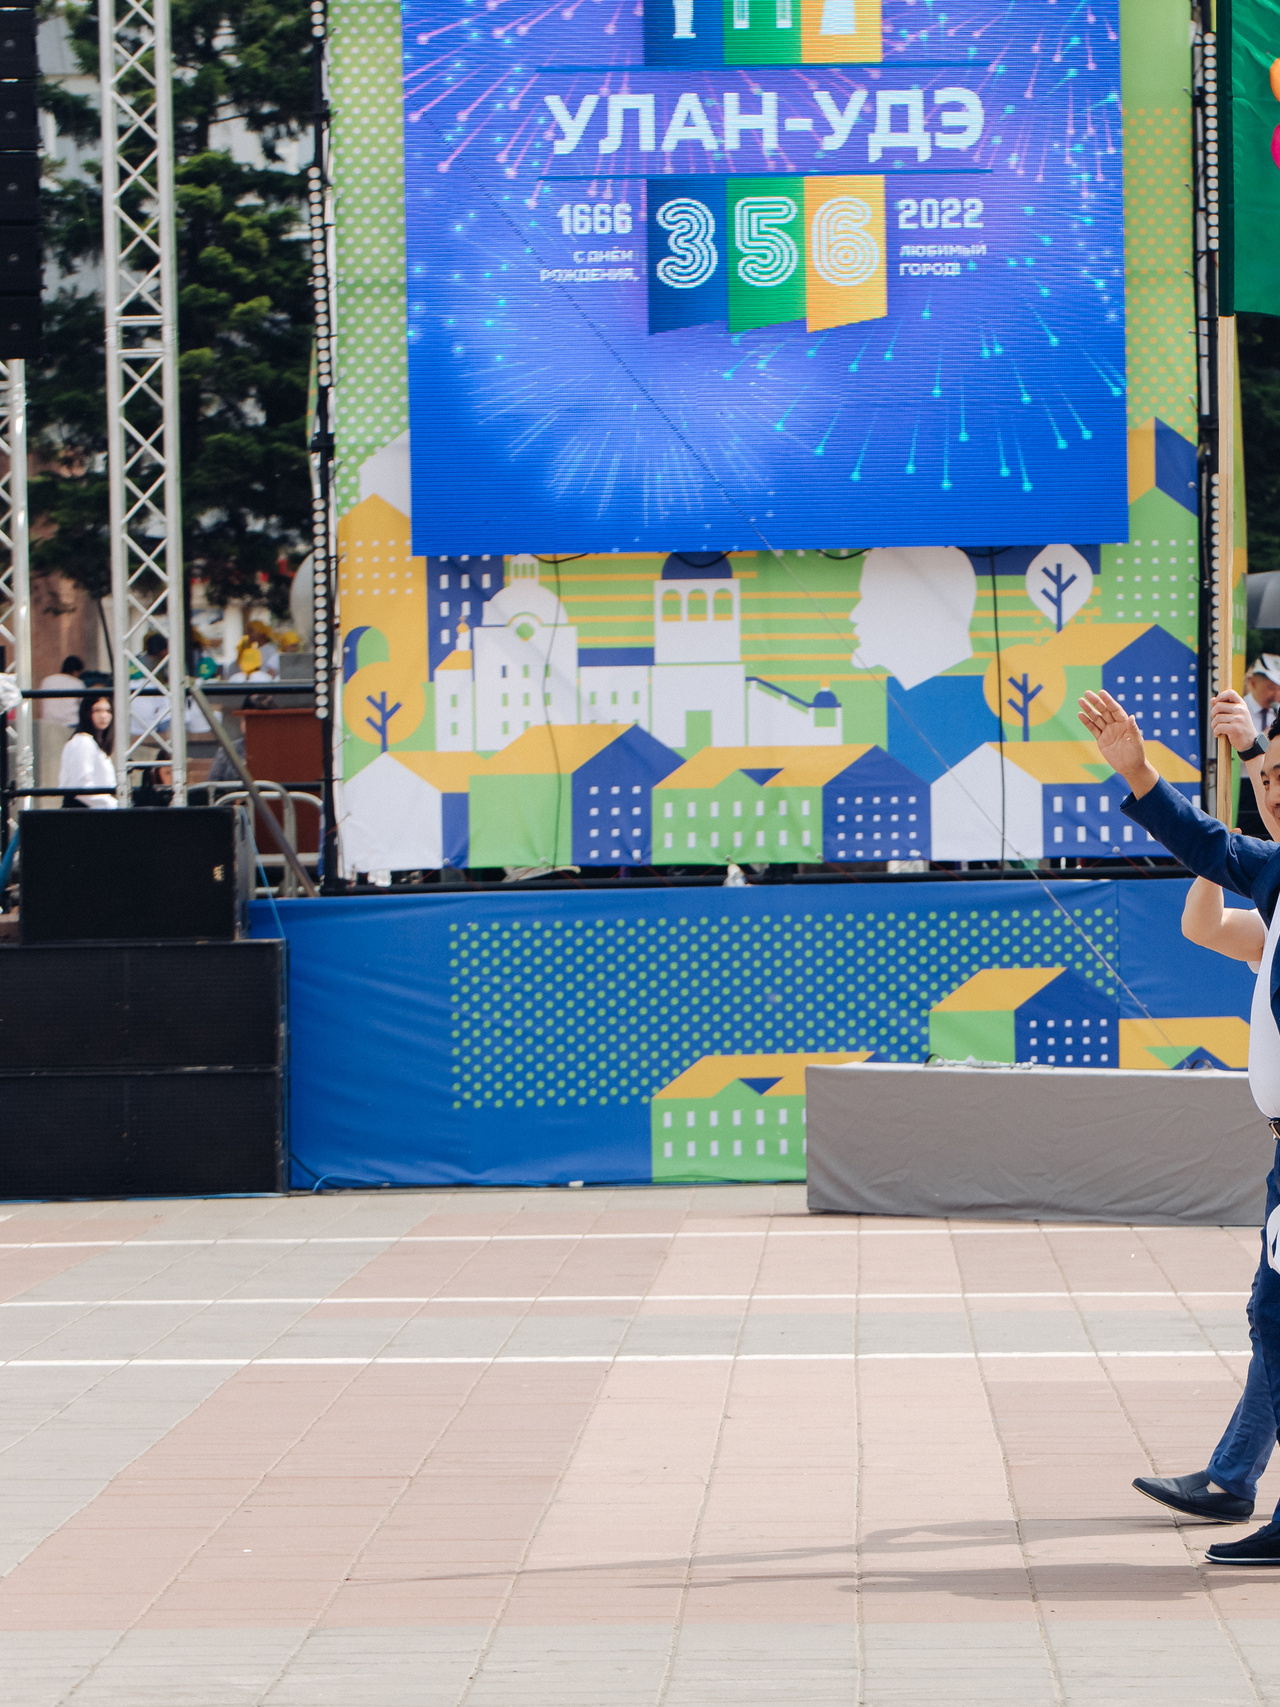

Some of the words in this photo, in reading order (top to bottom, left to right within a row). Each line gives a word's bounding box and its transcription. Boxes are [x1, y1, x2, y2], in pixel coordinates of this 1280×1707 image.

[544, 87, 985, 162] УЛАН-УДЭ
[556, 203, 633, 236] 1666
[898, 198, 984, 229] 2022
[656, 196, 880, 289] 356
